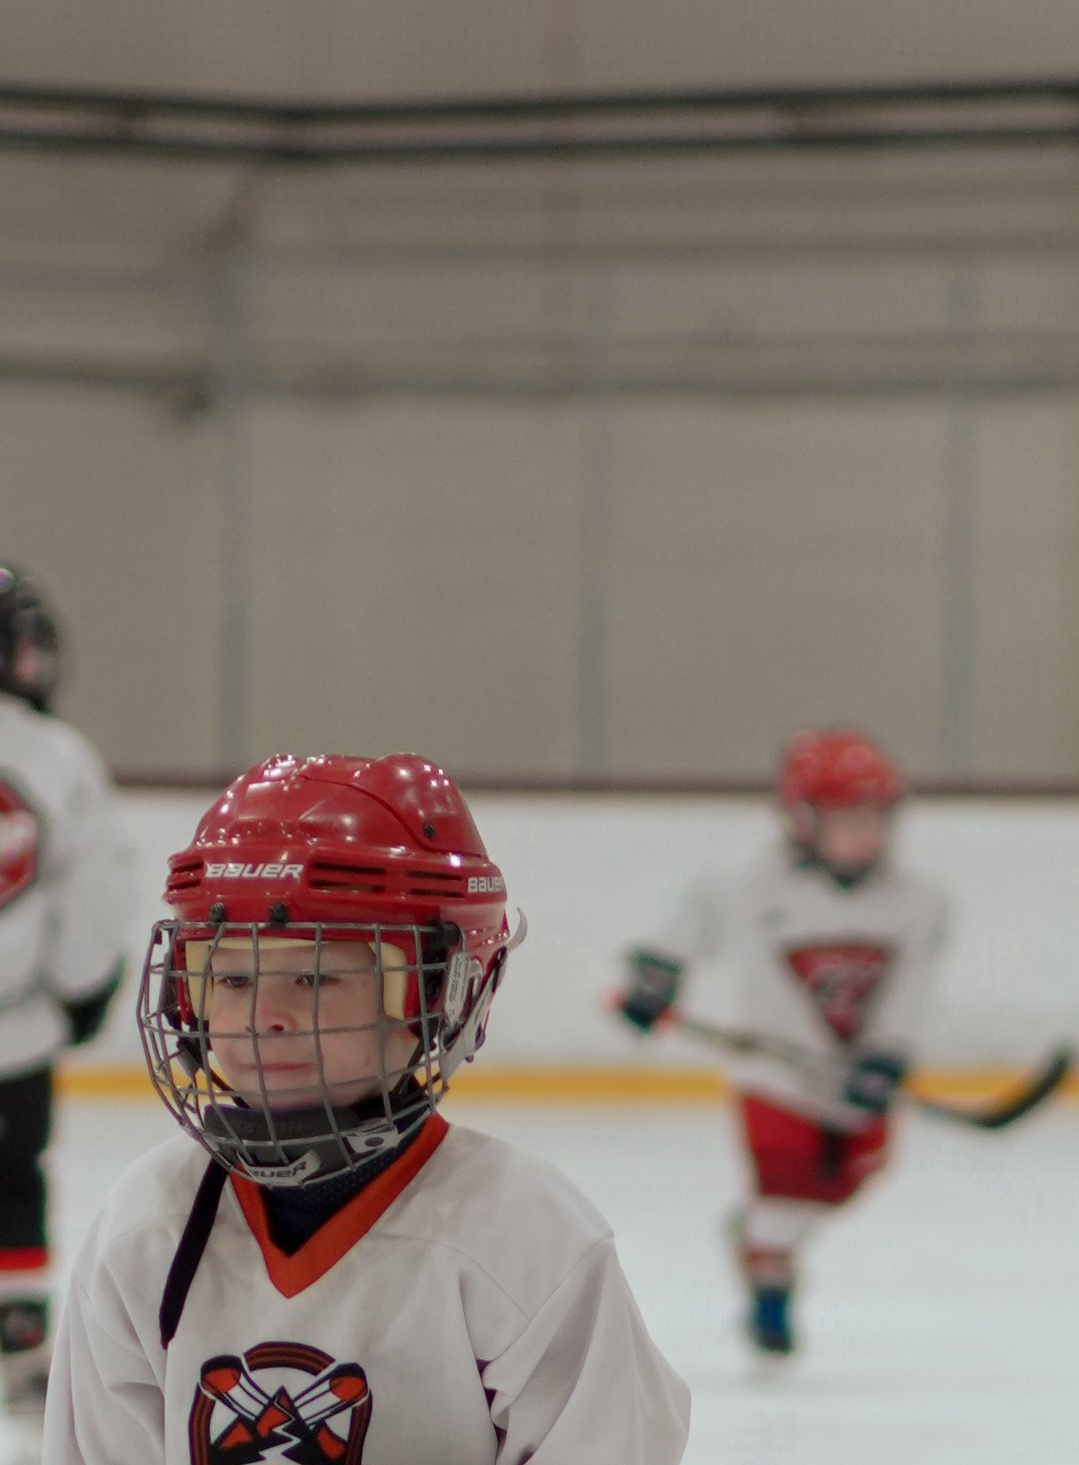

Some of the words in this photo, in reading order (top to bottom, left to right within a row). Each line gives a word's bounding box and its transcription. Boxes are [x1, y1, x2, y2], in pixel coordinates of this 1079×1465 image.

[204, 862, 304, 881] BAUER
[467, 876, 504, 893] BAUE
[251, 1160, 307, 1179] UER
